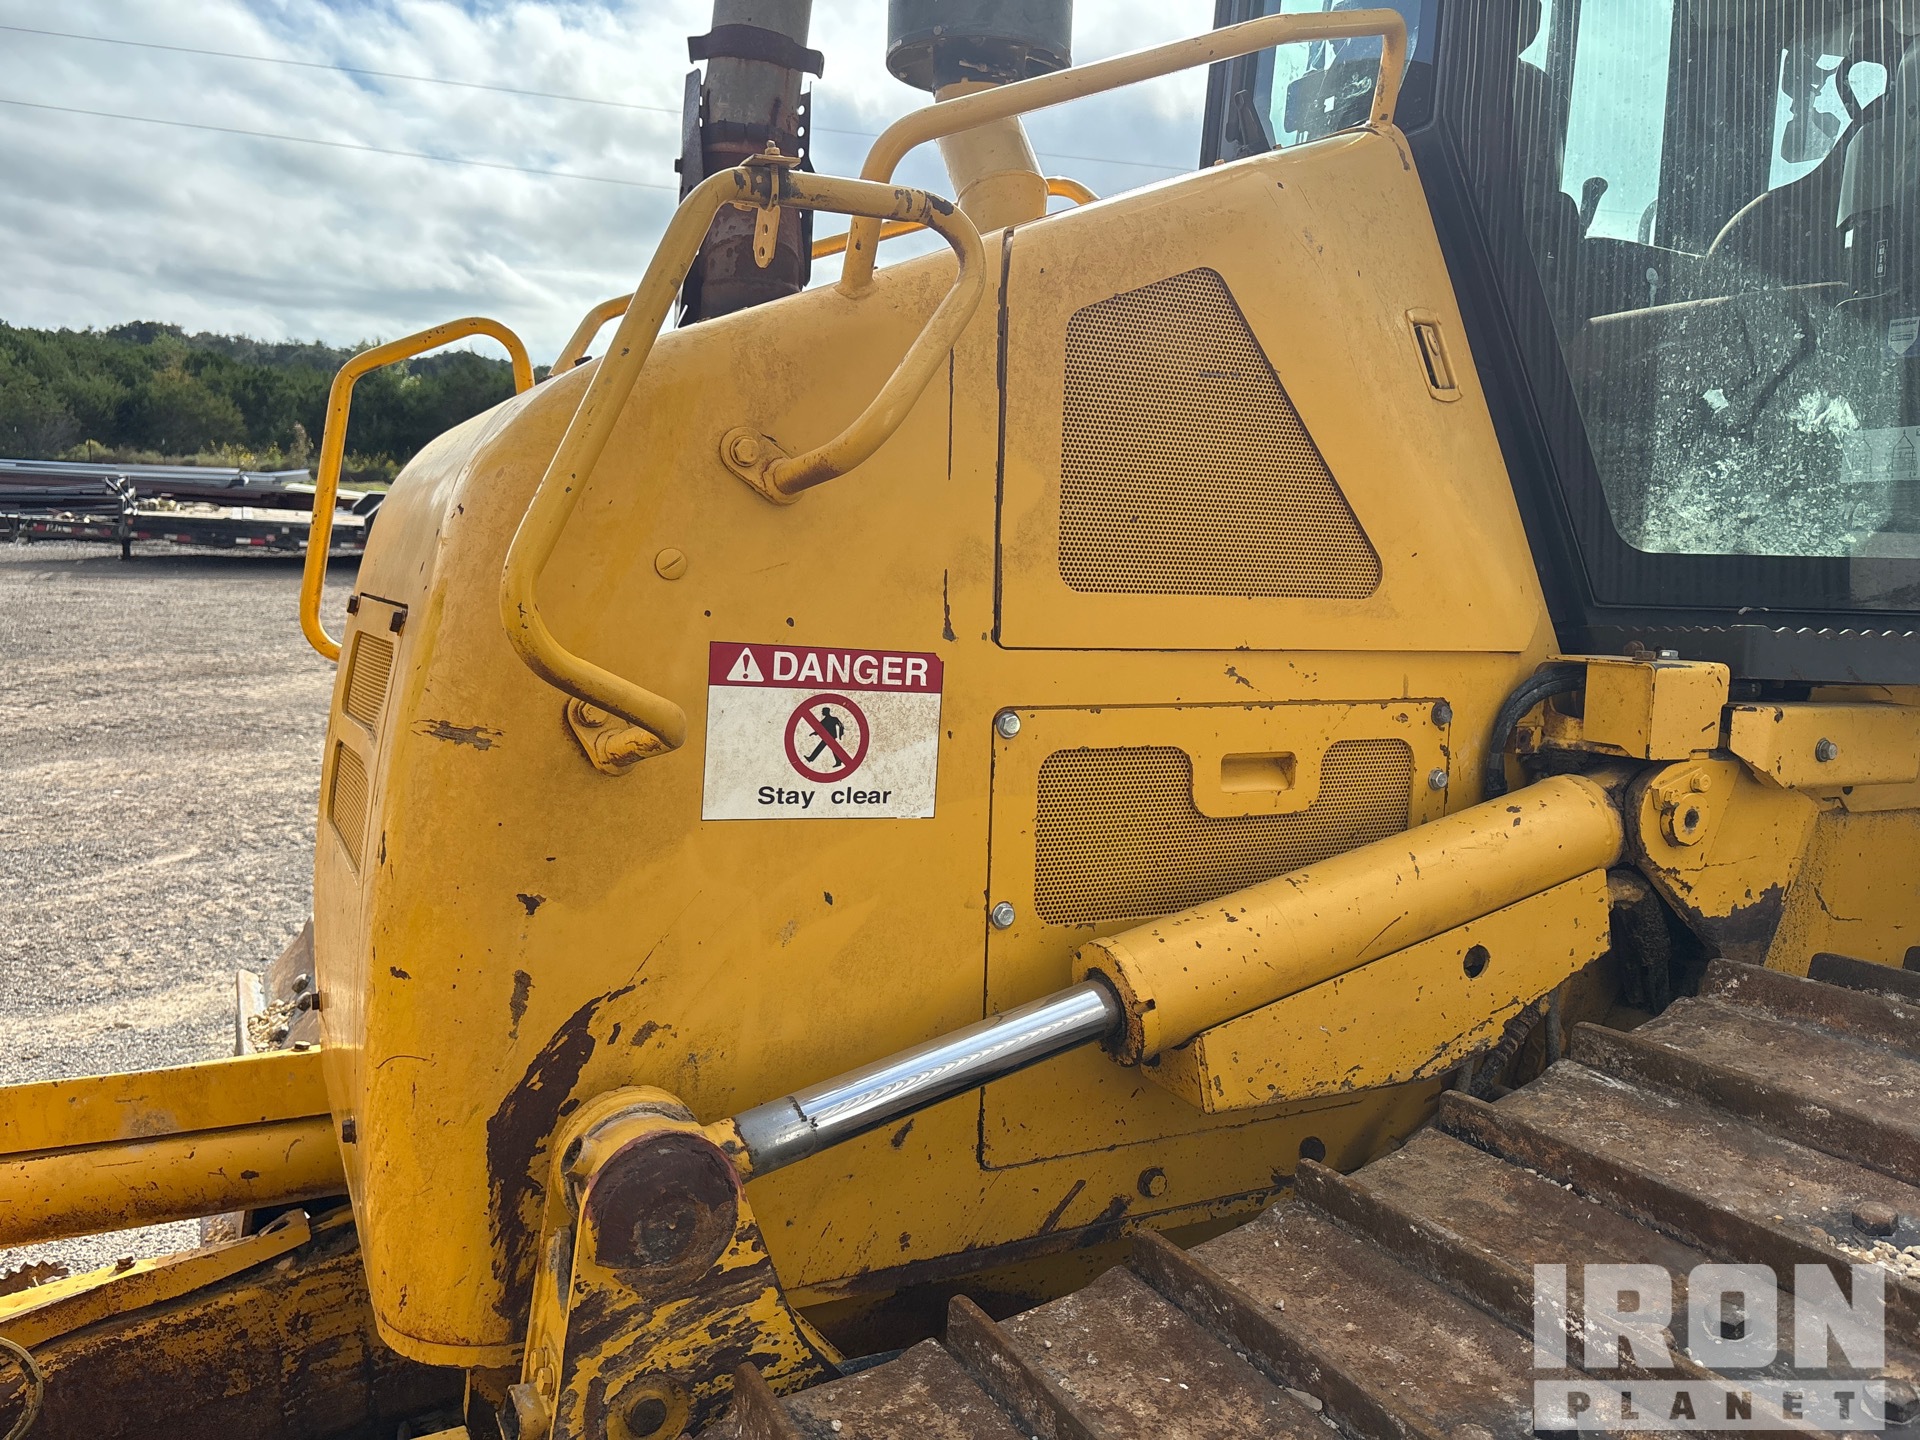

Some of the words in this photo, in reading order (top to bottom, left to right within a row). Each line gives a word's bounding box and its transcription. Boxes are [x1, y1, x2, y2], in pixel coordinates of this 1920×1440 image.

[772, 651, 928, 686] DANGER
[757, 786, 815, 809] Stay
[830, 786, 892, 805] clear
